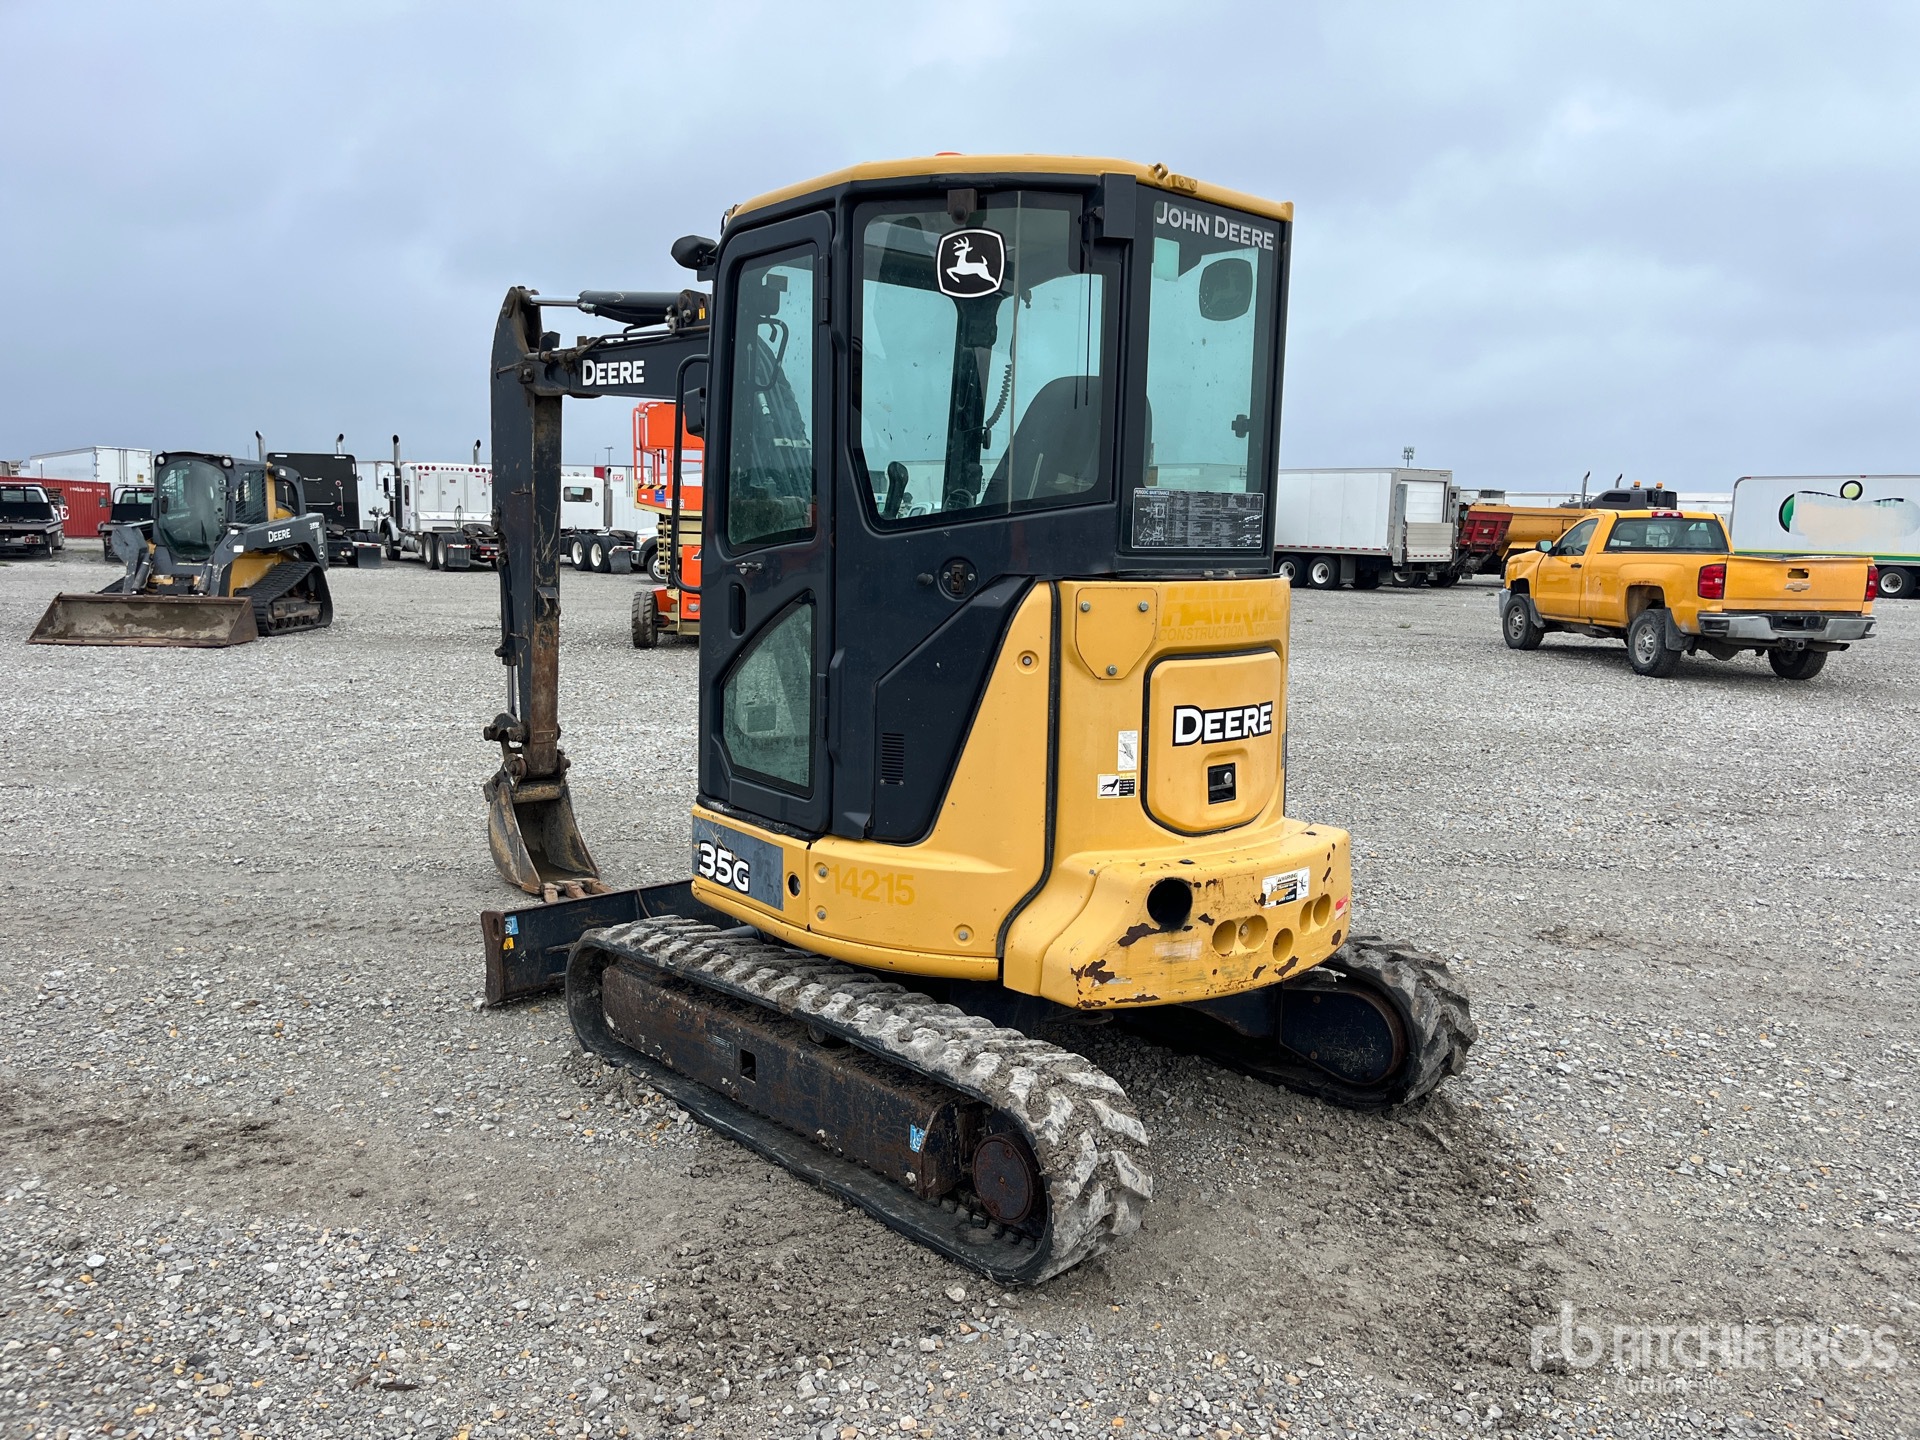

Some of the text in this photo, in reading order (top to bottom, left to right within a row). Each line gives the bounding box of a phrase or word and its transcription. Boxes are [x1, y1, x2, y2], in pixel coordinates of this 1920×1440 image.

[1156, 201, 1275, 252] JOHN DEERE
[582, 358, 646, 387] DEERE
[268, 528, 292, 543] DEERE
[1159, 624, 1245, 642] CONSTRUCTION
[1174, 701, 1273, 746] DEERE
[698, 841, 750, 894] 35G
[829, 863, 916, 906] 14215
